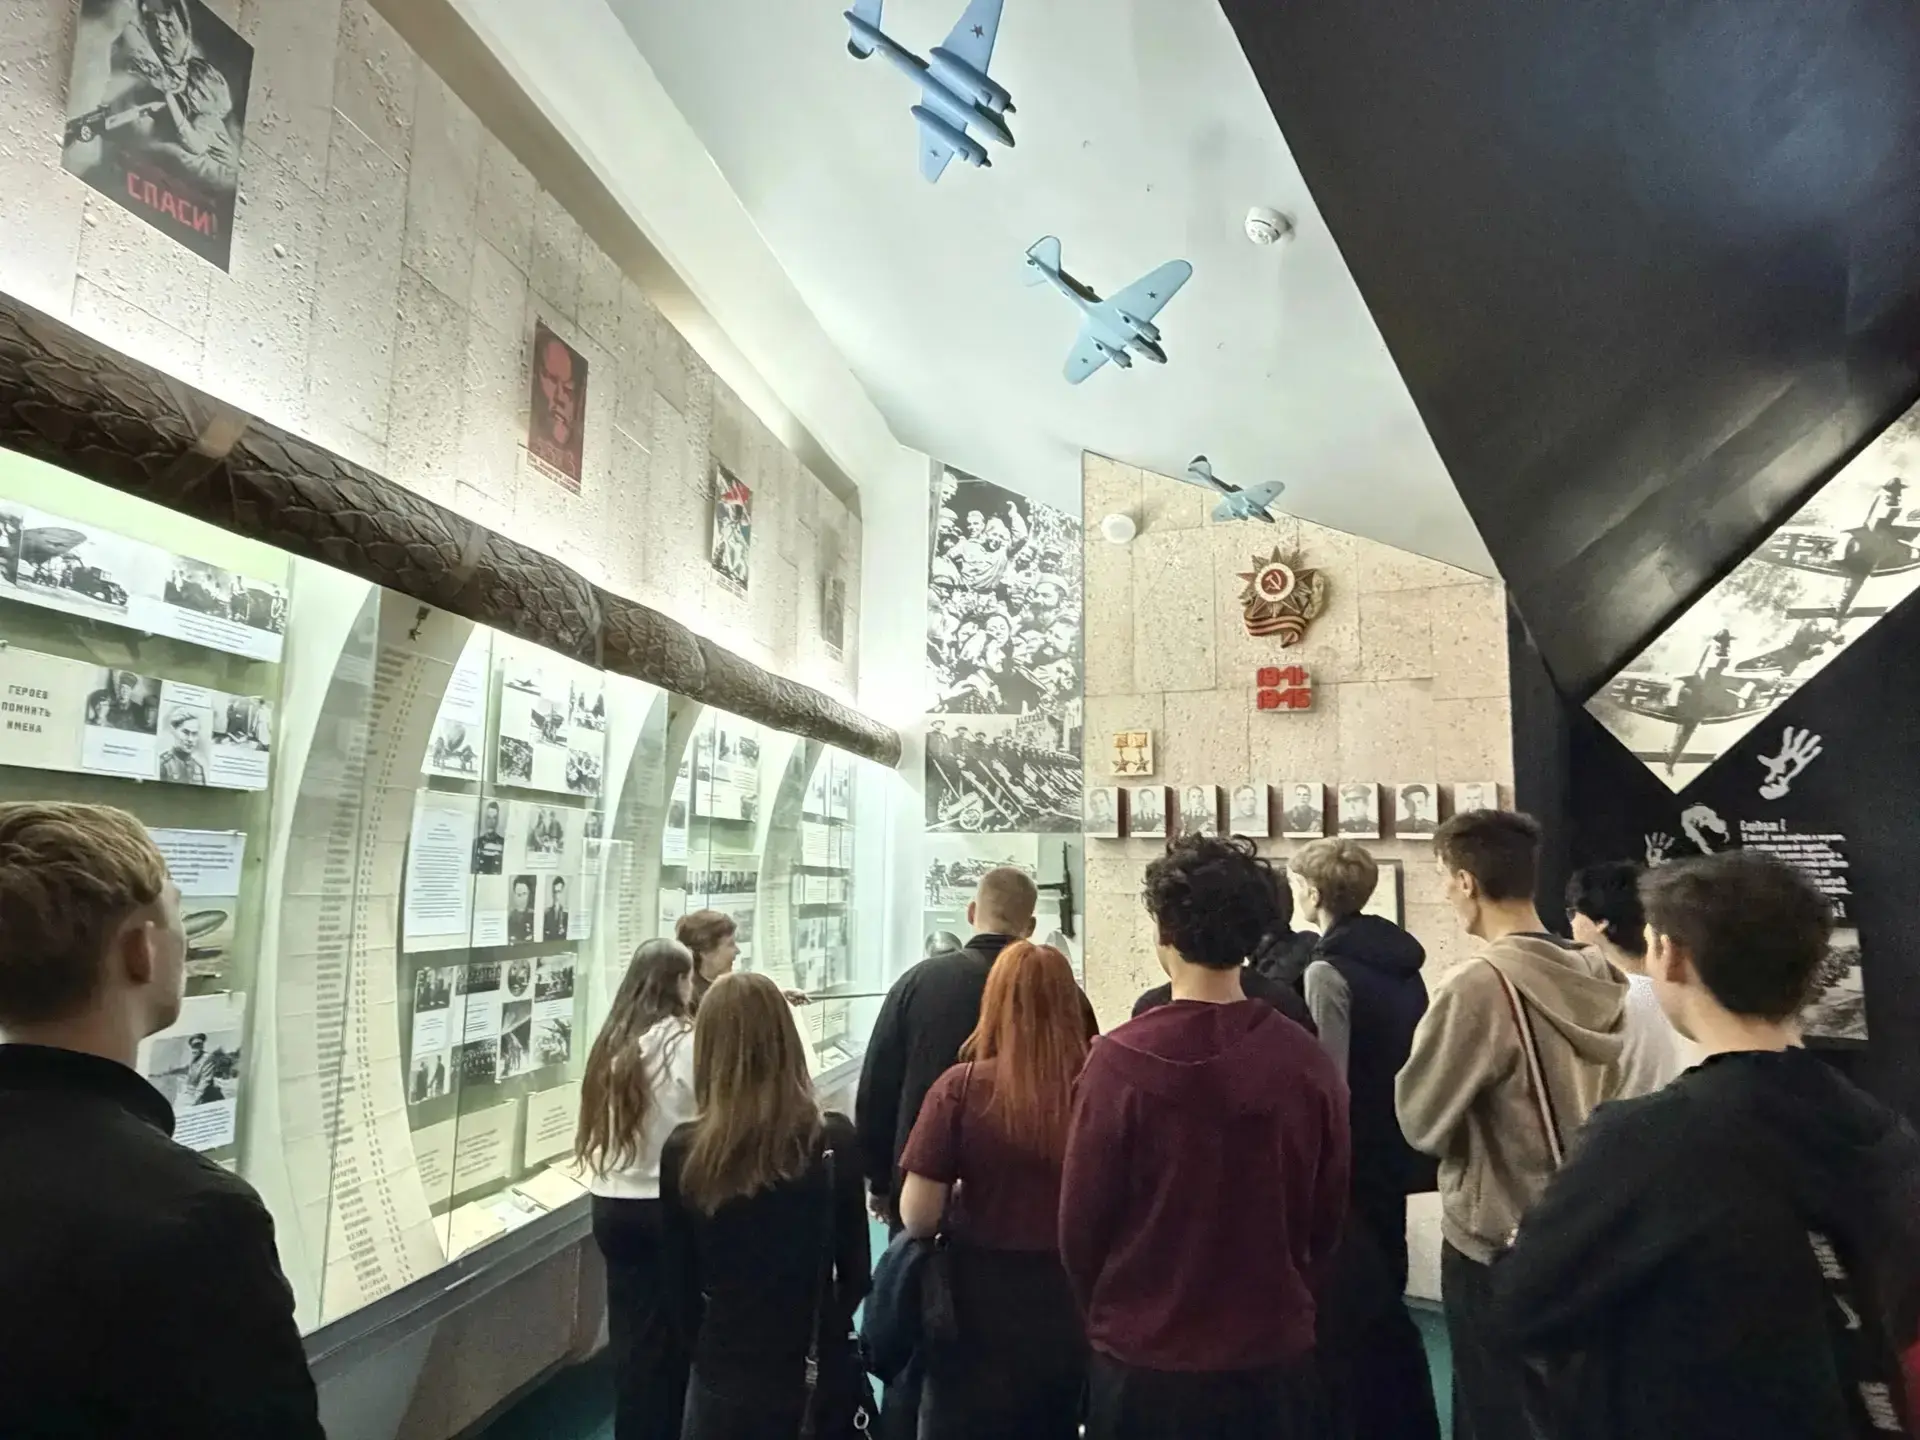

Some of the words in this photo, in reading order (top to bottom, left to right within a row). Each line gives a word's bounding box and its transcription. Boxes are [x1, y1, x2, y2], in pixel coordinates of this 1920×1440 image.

[127, 172, 218, 240] СПАСИ!
[8, 684, 49, 700] ГЕРОЕВ
[1258, 689, 1311, 709] 1945
[6, 720, 42, 733] ИМЕНА
